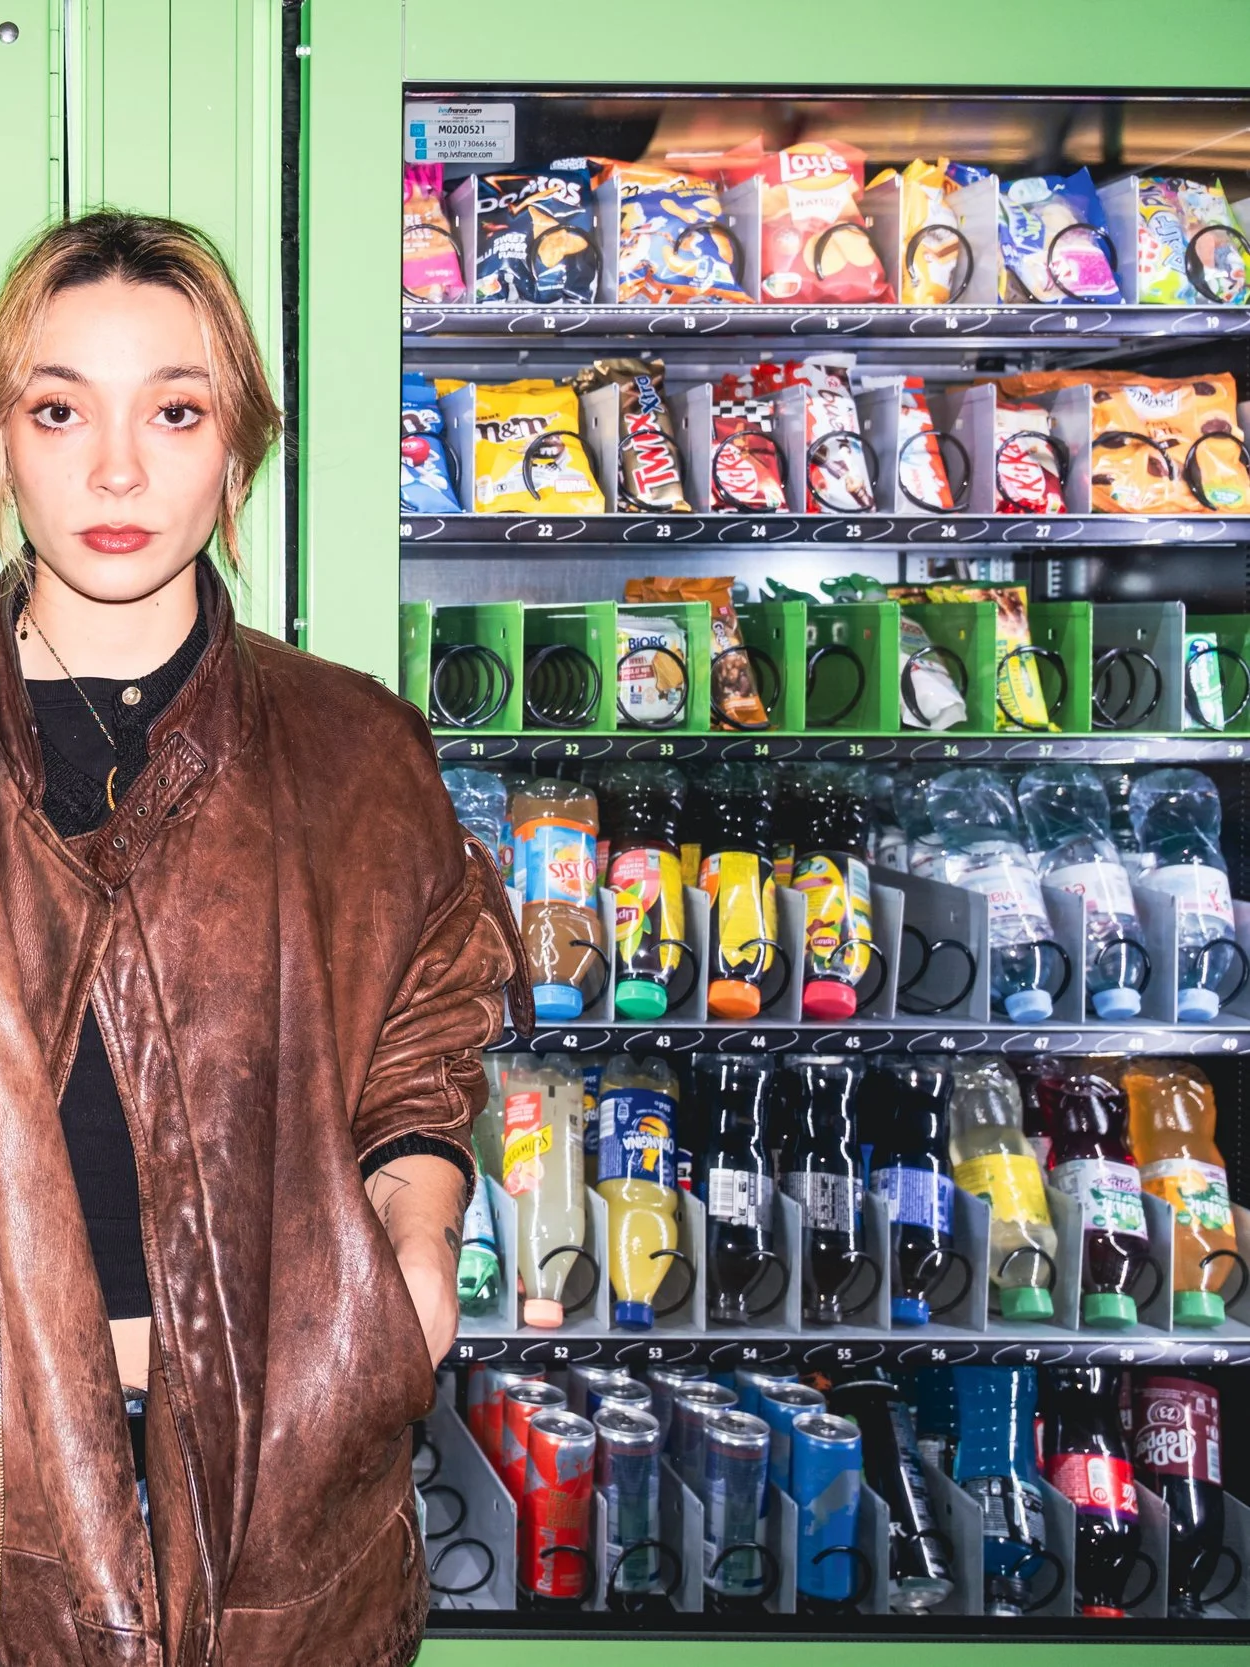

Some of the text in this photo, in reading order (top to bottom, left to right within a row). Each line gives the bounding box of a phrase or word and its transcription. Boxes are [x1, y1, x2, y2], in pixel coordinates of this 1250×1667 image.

[438, 125, 485, 134] M0200521
[779, 151, 847, 184] Lay's
[403, 316, 412, 328] 0
[544, 317, 555, 328] 12
[685, 317, 695, 328] 13
[827, 317, 838, 328] 15
[946, 317, 958, 328] 16
[1065, 316, 1078, 329] 18
[1207, 317, 1219, 328] 19
[538, 524, 552, 536] 22
[657, 525, 671, 536] 23
[752, 525, 766, 537] 24
[847, 525, 861, 537] 25
[941, 525, 956, 537] 26
[1036, 525, 1051, 537] 27
[471, 743, 483, 755] 31
[566, 744, 579, 755] 32
[660, 744, 673, 755] 33
[755, 744, 768, 755] 34
[850, 745, 863, 755] 35
[944, 745, 959, 756] 36
[1039, 744, 1052, 756] 37
[1229, 744, 1242, 756] 39
[813, 938, 836, 946] Lipton
[563, 1035, 577, 1047] 42
[656, 1036, 670, 1047] 43
[751, 1036, 765, 1047] 44
[846, 1037, 860, 1048] 45
[940, 1037, 955, 1048] 46
[1034, 1037, 1049, 1049] 47
[1128, 1038, 1144, 1050] 48
[1223, 1036, 1237, 1049] 49
[460, 1346, 473, 1357] 51
[555, 1347, 568, 1358] 52
[649, 1348, 662, 1358] 53
[744, 1348, 756, 1359] 54
[838, 1349, 851, 1359] 55
[932, 1349, 946, 1360] 56
[1026, 1349, 1040, 1360] 57
[1120, 1349, 1134, 1360] 58
[1214, 1349, 1228, 1360] 59
[1162, 1406, 1182, 1420] 23
